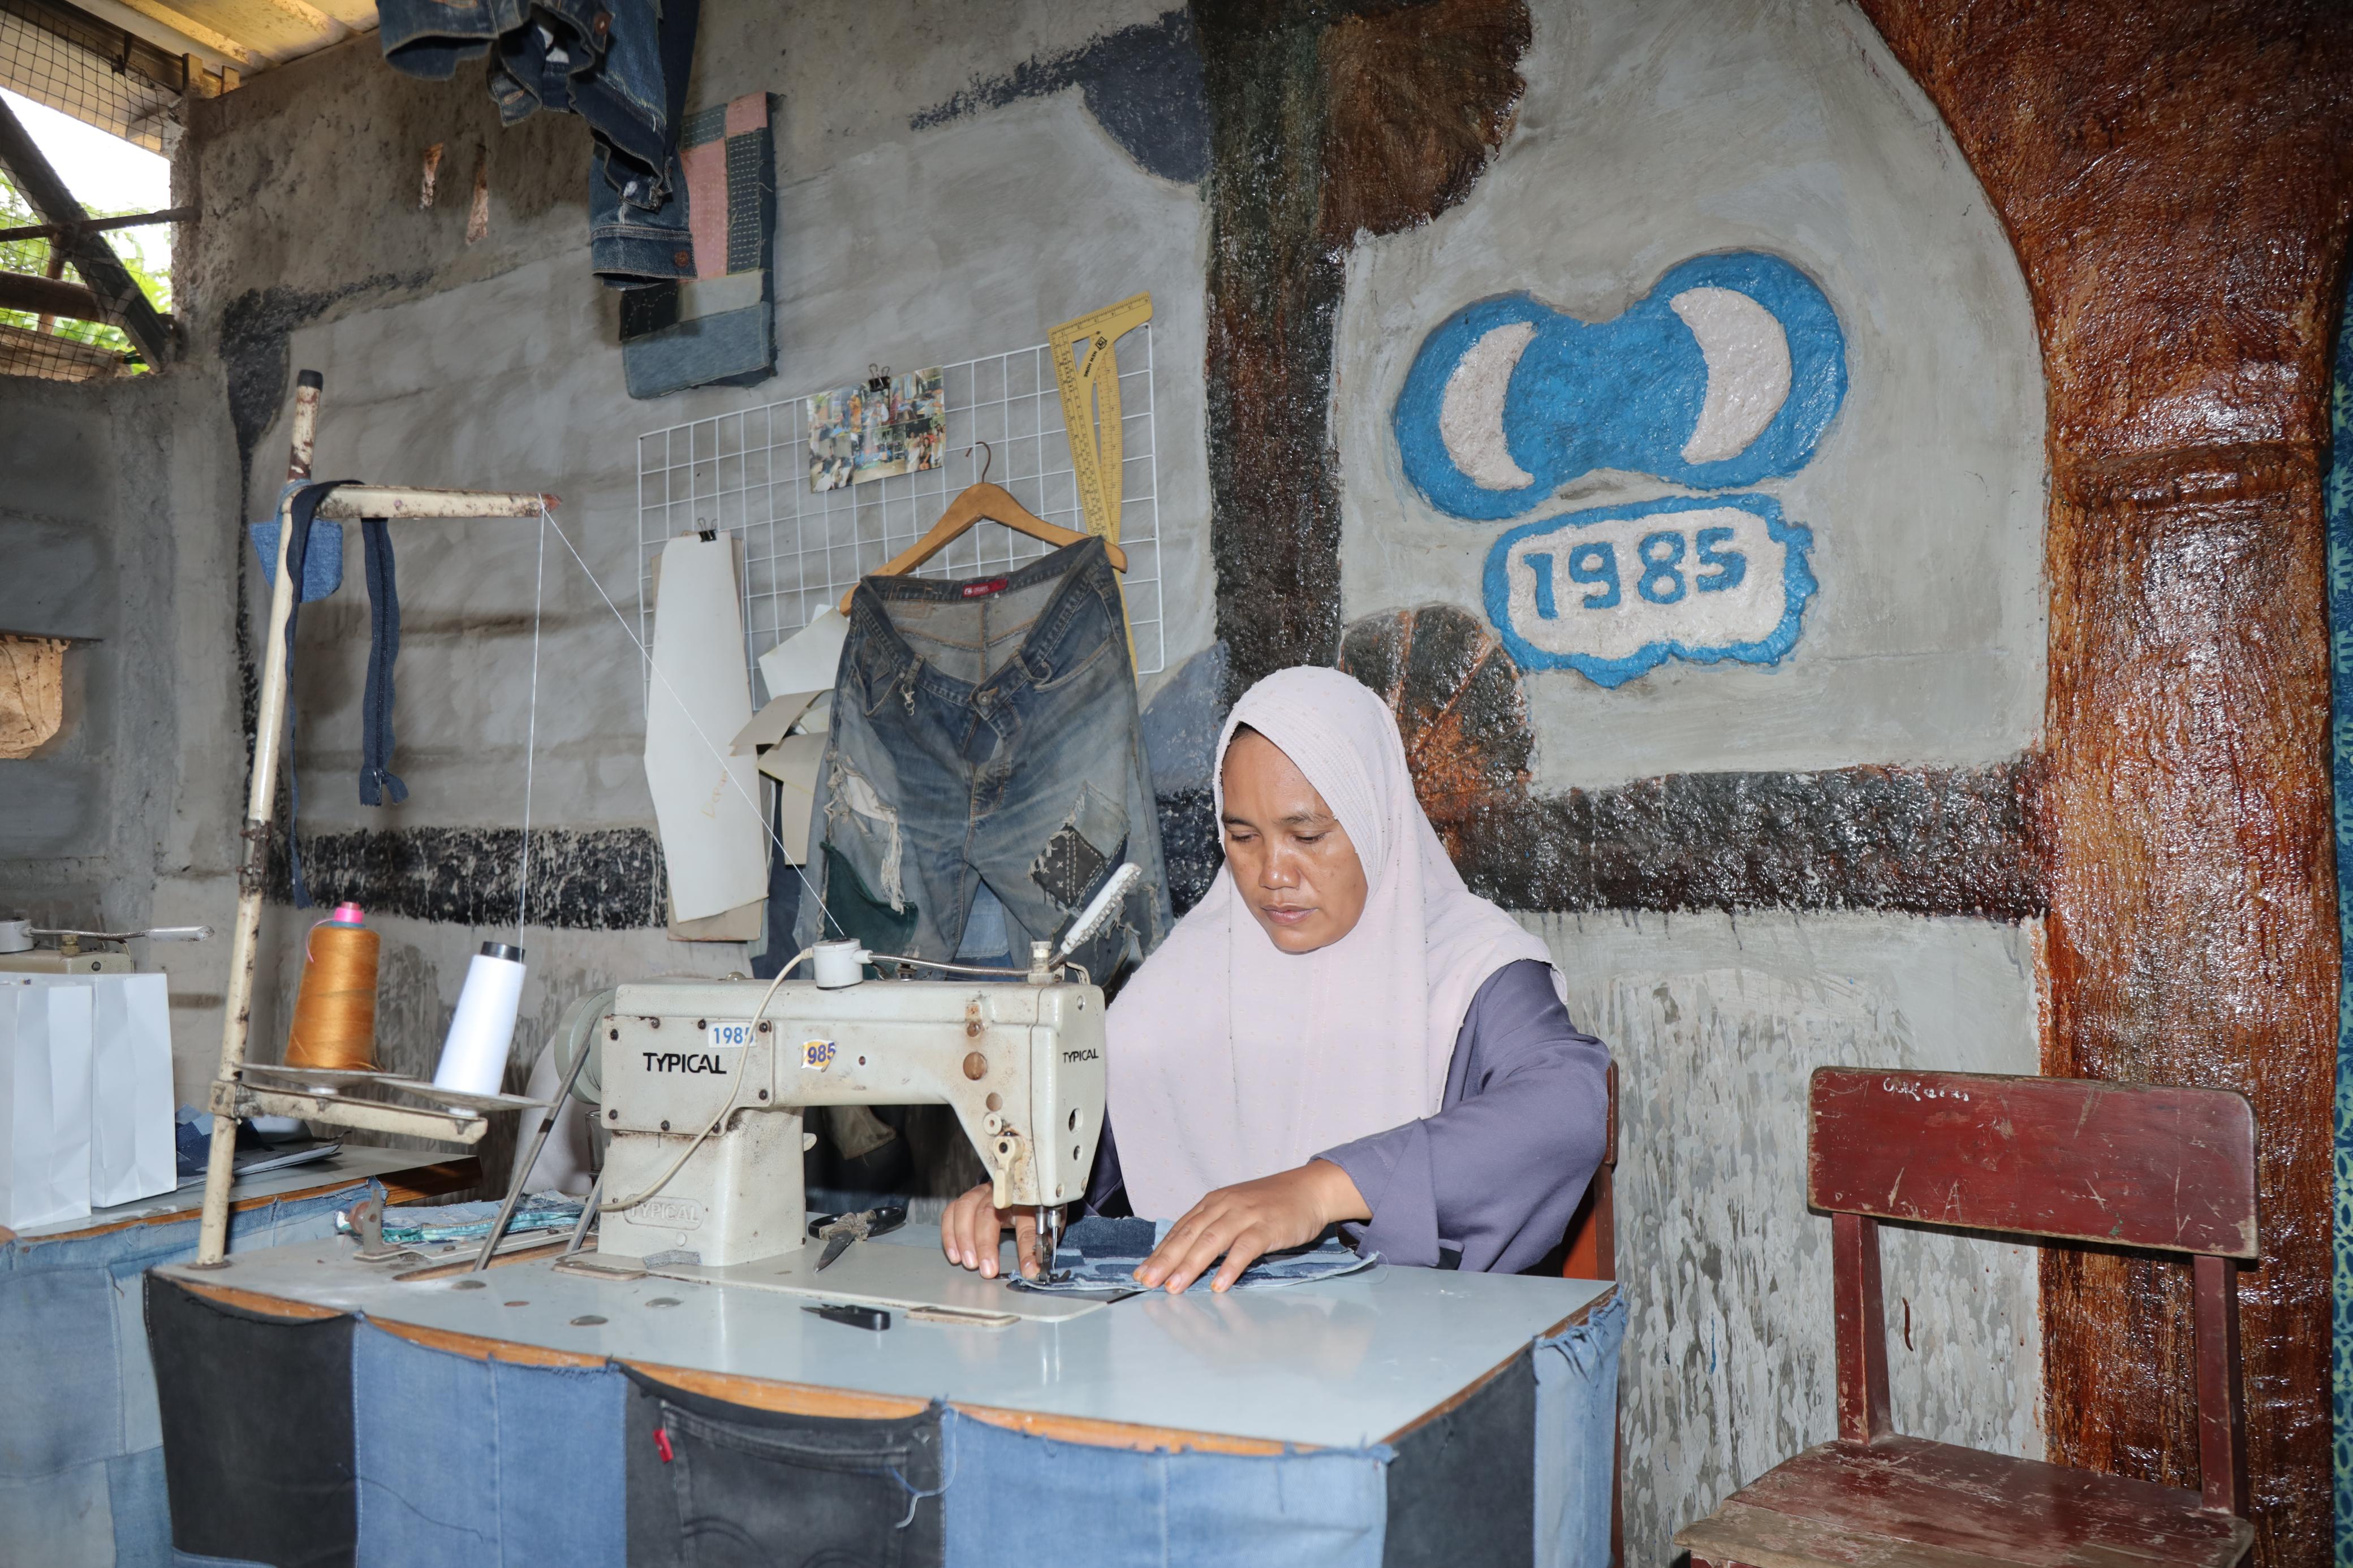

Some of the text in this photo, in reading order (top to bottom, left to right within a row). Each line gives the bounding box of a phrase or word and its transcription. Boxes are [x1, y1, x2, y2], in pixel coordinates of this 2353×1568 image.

[1083, 362, 1092, 378] HOME
[1523, 527, 1747, 621] 1985
[643, 1052, 727, 1074] TYPICAL
[1062, 1048, 1099, 1064] TYPICAL
[630, 1203, 701, 1225] TYPICAL
